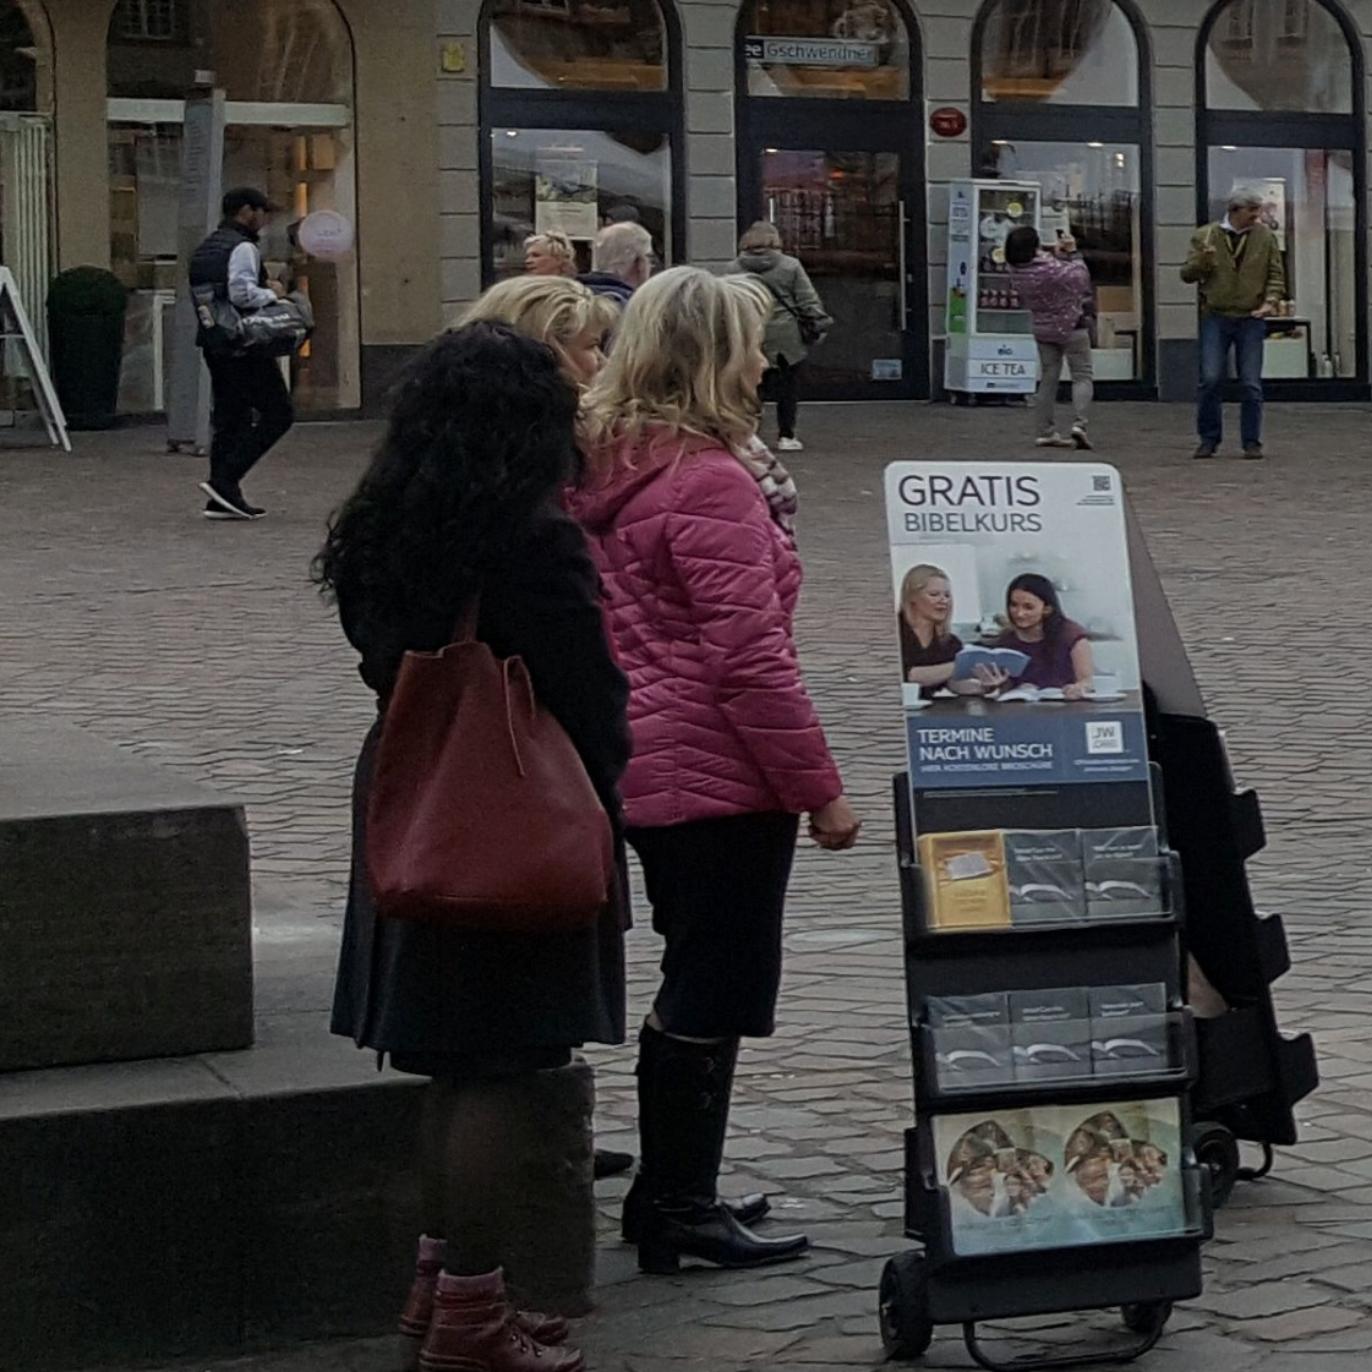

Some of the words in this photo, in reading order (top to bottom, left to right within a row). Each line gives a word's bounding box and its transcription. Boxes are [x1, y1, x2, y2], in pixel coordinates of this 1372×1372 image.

[980, 362, 1001, 376] ICE
[1002, 363, 1027, 376] TEA
[898, 475, 1041, 506] GRATIS
[904, 511, 1043, 533] BIBELKURS
[917, 727, 995, 744] TERMINE
[918, 745, 970, 761] NACH
[974, 743, 1054, 759] WUNSCH
